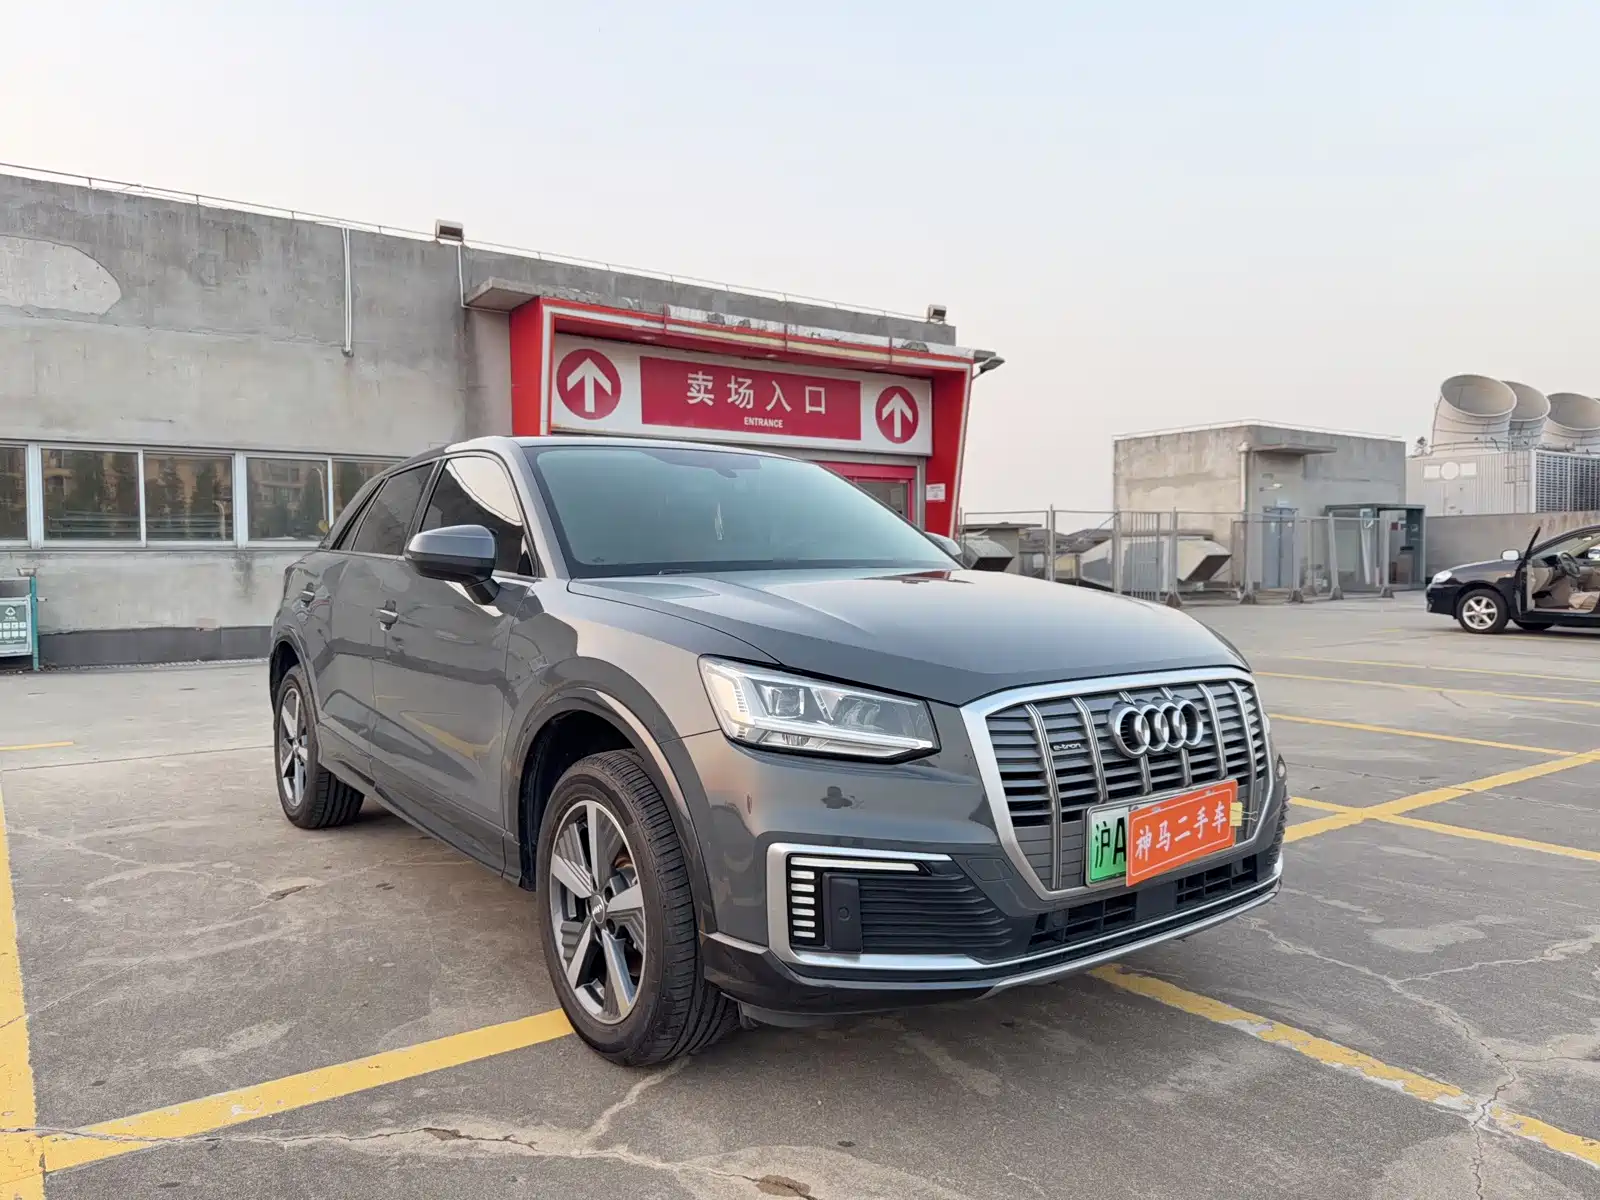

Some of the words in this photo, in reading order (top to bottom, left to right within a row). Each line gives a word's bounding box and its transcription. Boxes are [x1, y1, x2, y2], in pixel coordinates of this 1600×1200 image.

[686, 371, 827, 415] 卖场入口
[743, 416, 784, 428] ENTRANCE
[1134, 800, 1228, 862] 神马二手车
